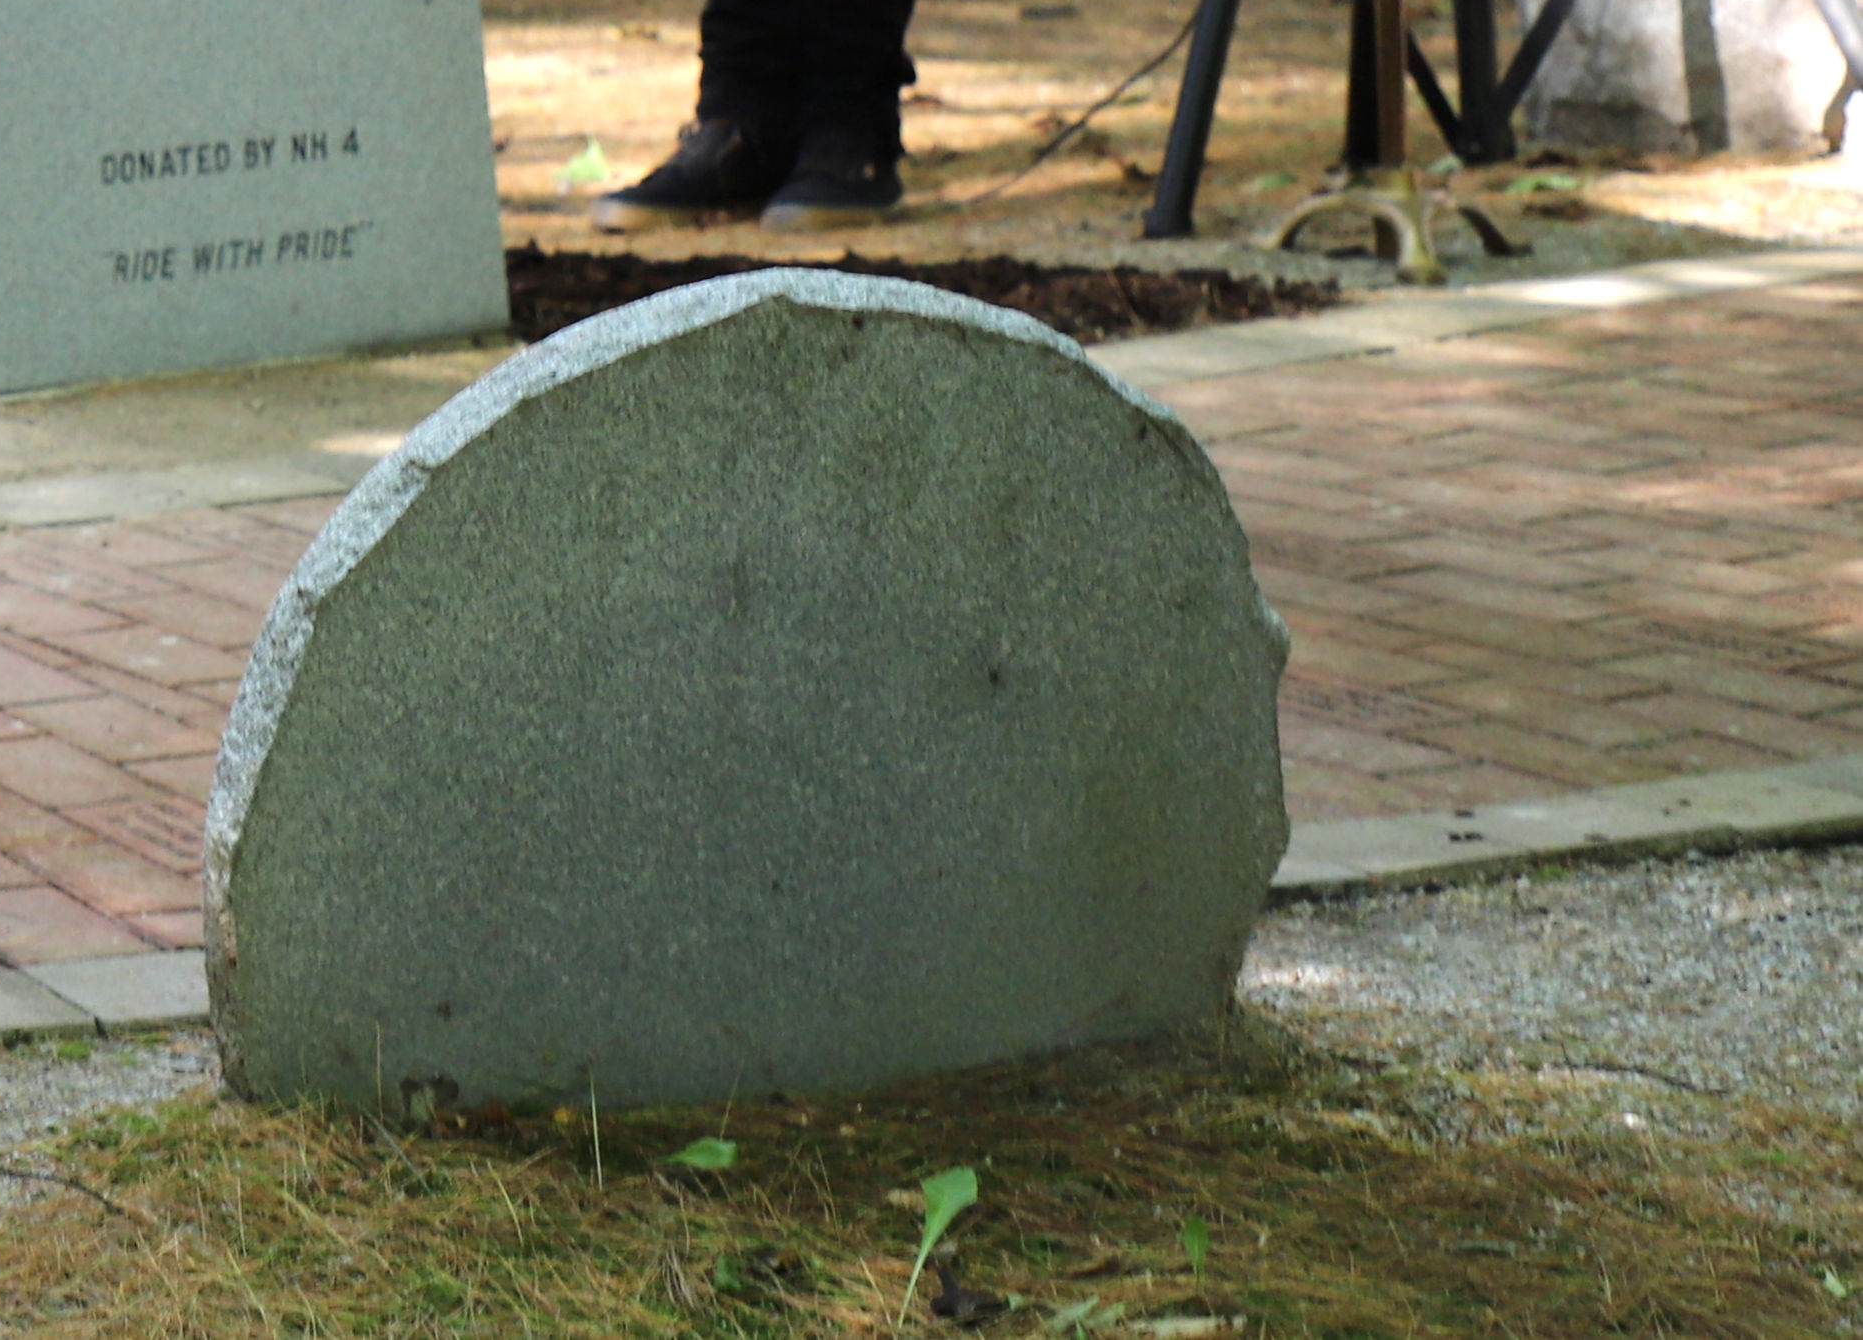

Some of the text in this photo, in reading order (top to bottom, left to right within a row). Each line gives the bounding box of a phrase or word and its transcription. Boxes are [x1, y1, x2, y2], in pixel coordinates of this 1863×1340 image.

[101, 126, 359, 186] DONATED BY NH 4
[192, 238, 264, 275] WITH
